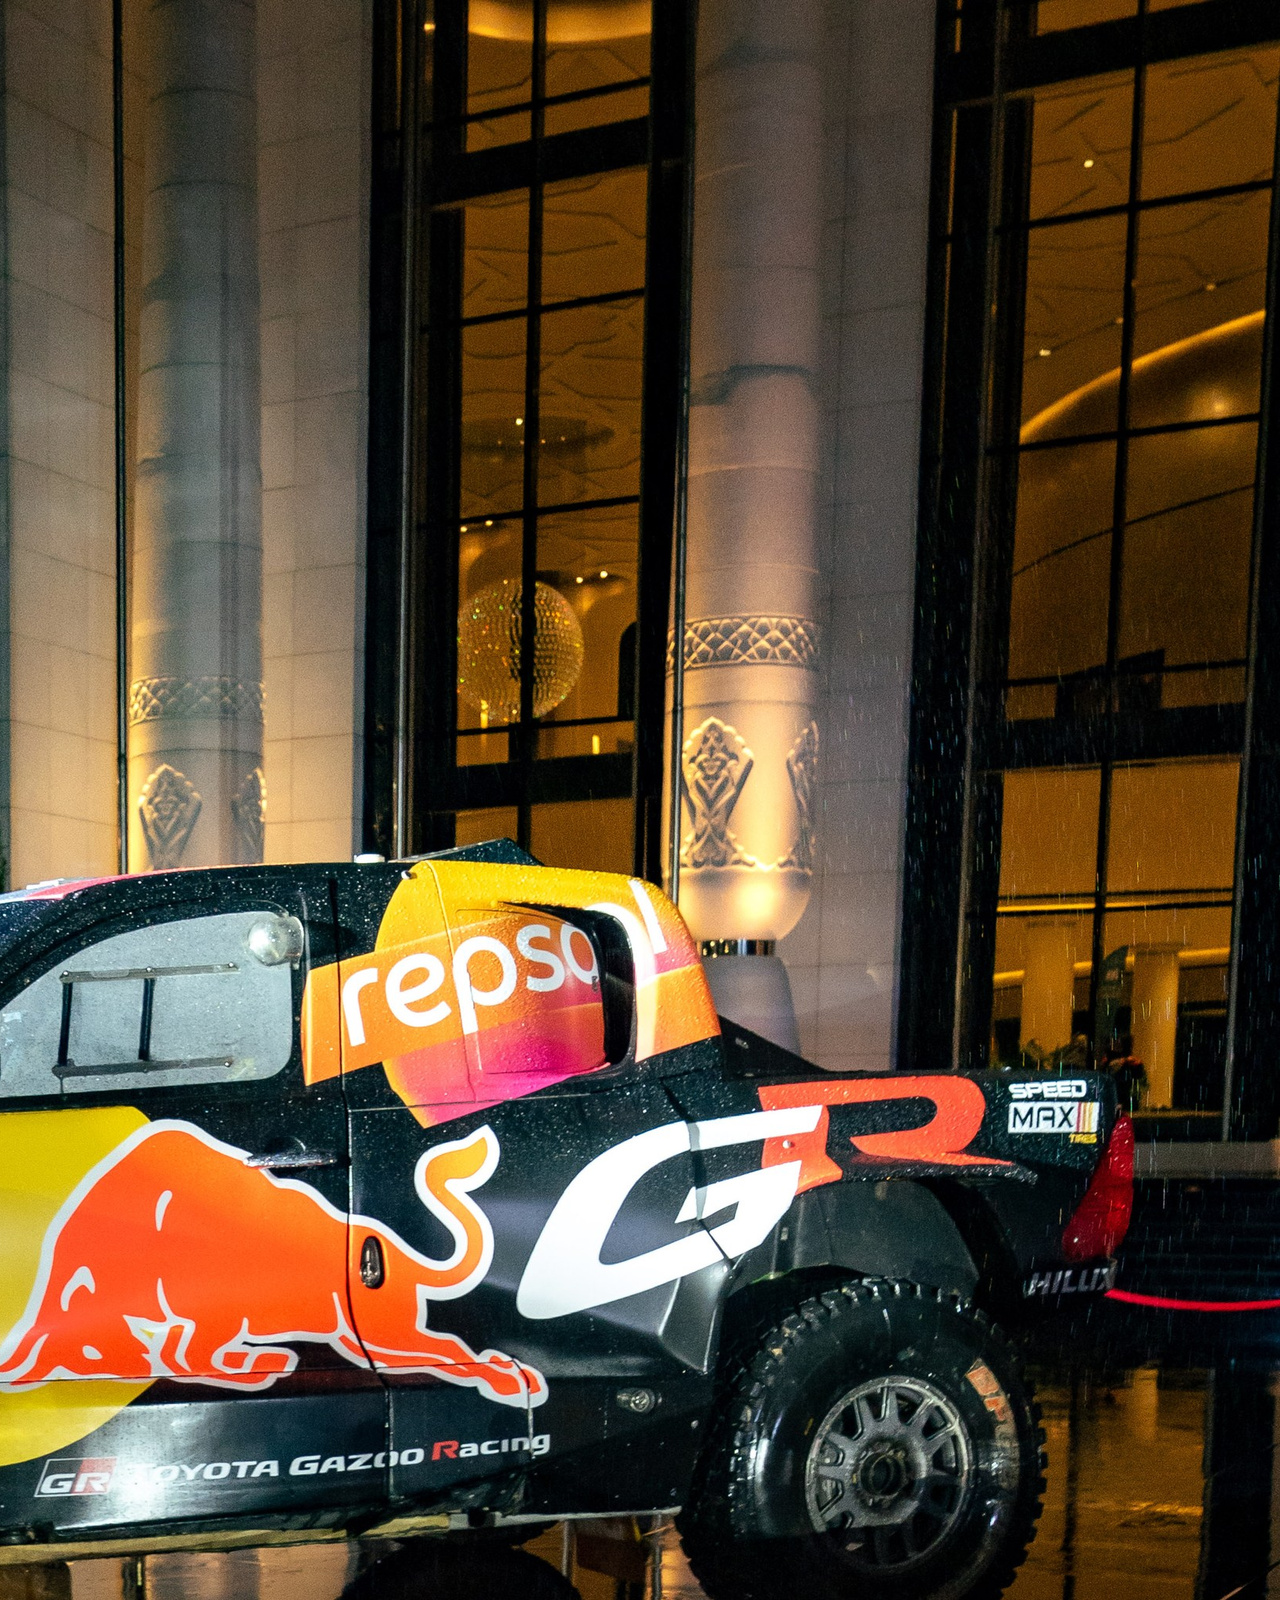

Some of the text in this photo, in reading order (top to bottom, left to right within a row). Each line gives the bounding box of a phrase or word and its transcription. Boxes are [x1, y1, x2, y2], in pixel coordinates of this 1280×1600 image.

[1008, 1080, 1087, 1099] SPEED
[1012, 1106, 1075, 1128] MAX
[516, 1075, 1015, 1320] GR
[40, 1472, 110, 1494] GR
[289, 1448, 425, 1476] GAZOO
[431, 1434, 551, 1461] Racing
